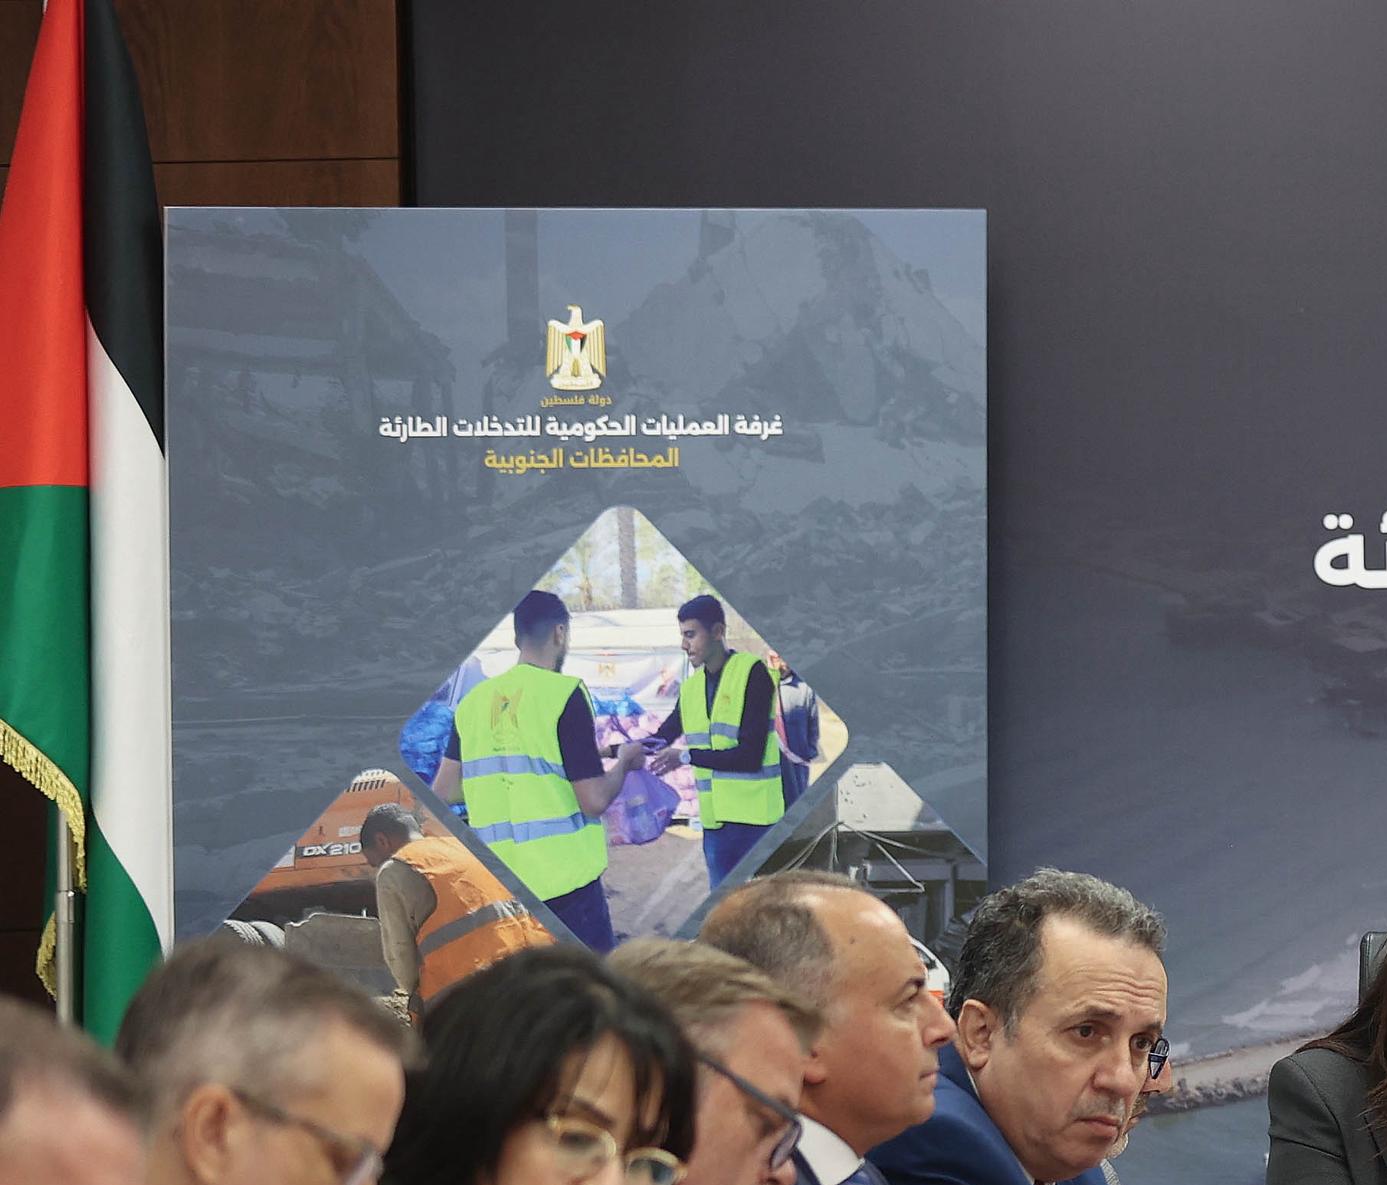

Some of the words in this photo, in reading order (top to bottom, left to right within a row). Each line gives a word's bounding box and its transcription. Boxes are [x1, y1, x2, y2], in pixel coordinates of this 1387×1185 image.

[540, 395, 585, 408] فلسطين
[588, 395, 613, 408] دولة
[379, 416, 447, 443] الطارئة
[453, 415, 541, 438] للتدخلات
[545, 414, 636, 441] الحكومية
[641, 414, 730, 441] العمليات
[734, 413, 783, 441] غرفة
[484, 448, 563, 475] الجنوبية
[570, 447, 680, 469] المحافظات
